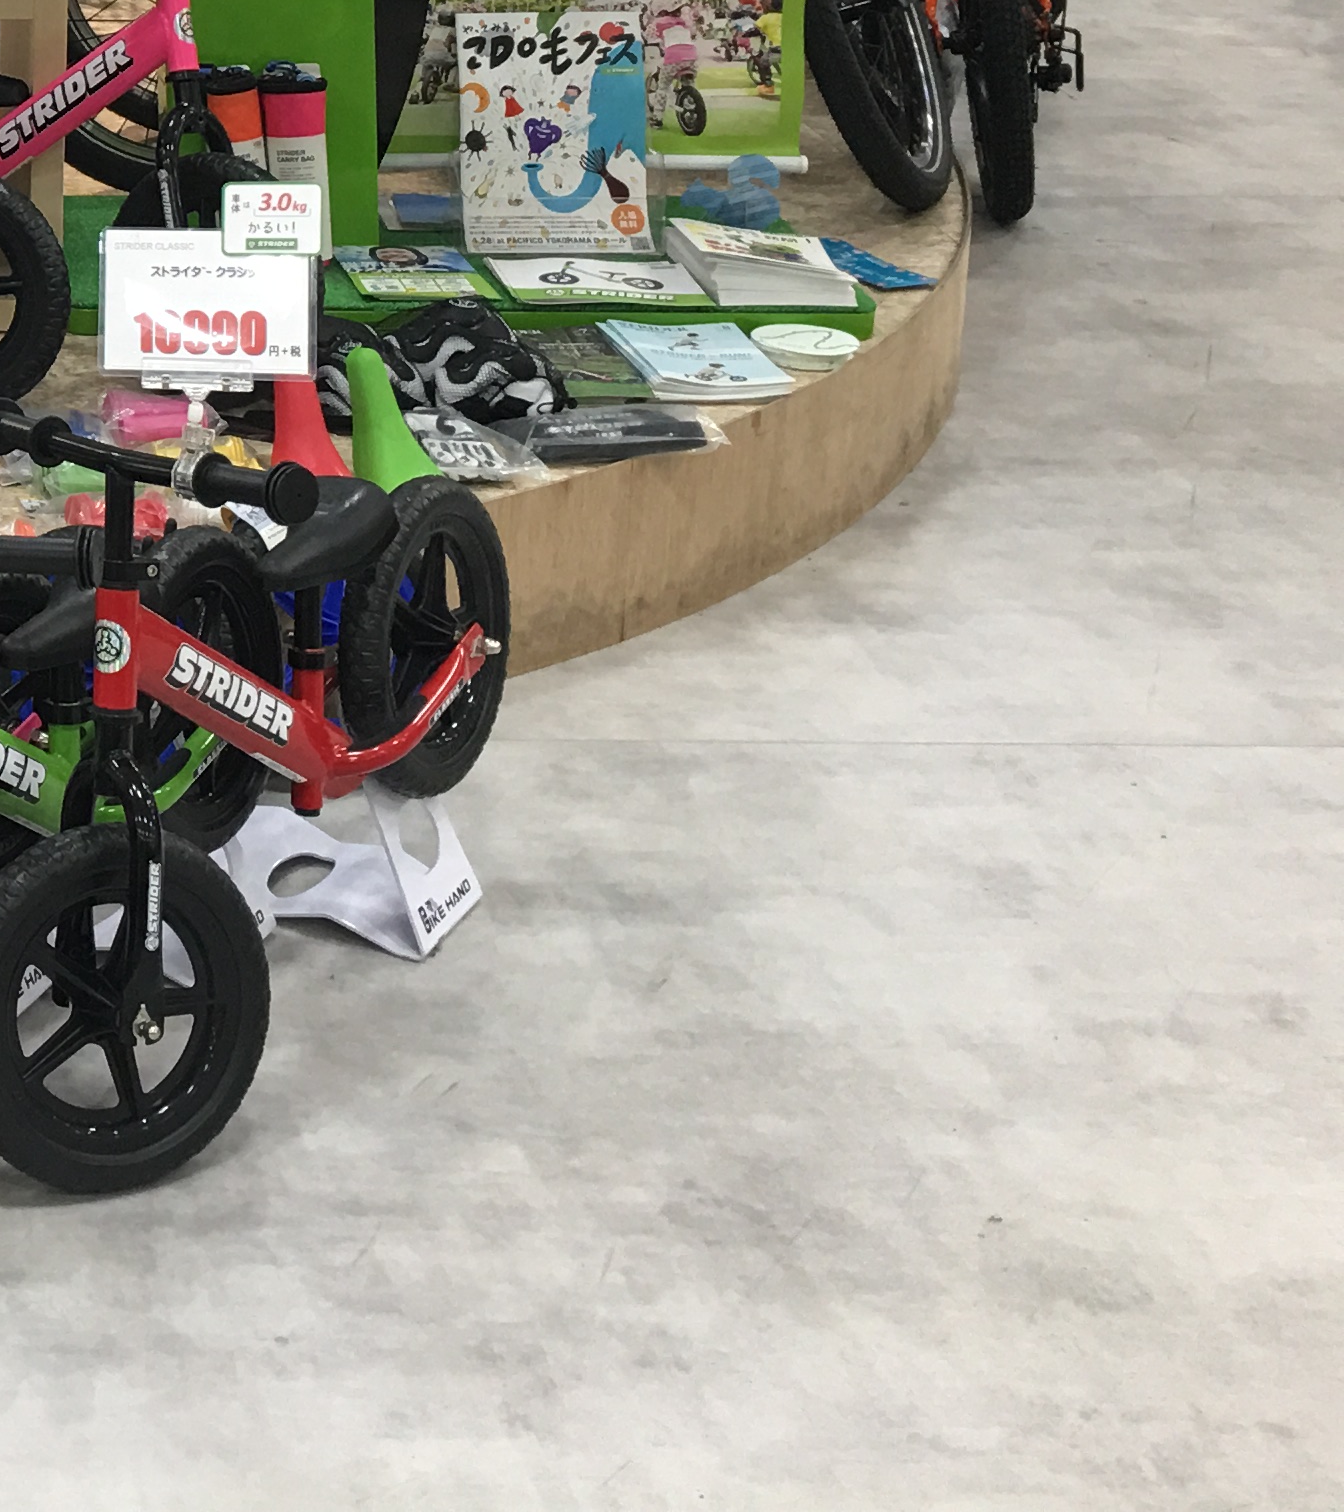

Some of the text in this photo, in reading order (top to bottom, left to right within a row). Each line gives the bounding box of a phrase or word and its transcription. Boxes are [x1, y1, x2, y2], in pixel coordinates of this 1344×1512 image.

[257, 192, 308, 214] 3.0kg
[247, 221, 297, 234] かるい!
[257, 240, 295, 248] STRIDER
[150, 265, 213, 279] ストライダー
[570, 290, 675, 301] STRIDER
[268, 345, 301, 358] 円+税
[166, 642, 295, 746] STRIDER
[444, 878, 472, 912] HAND
